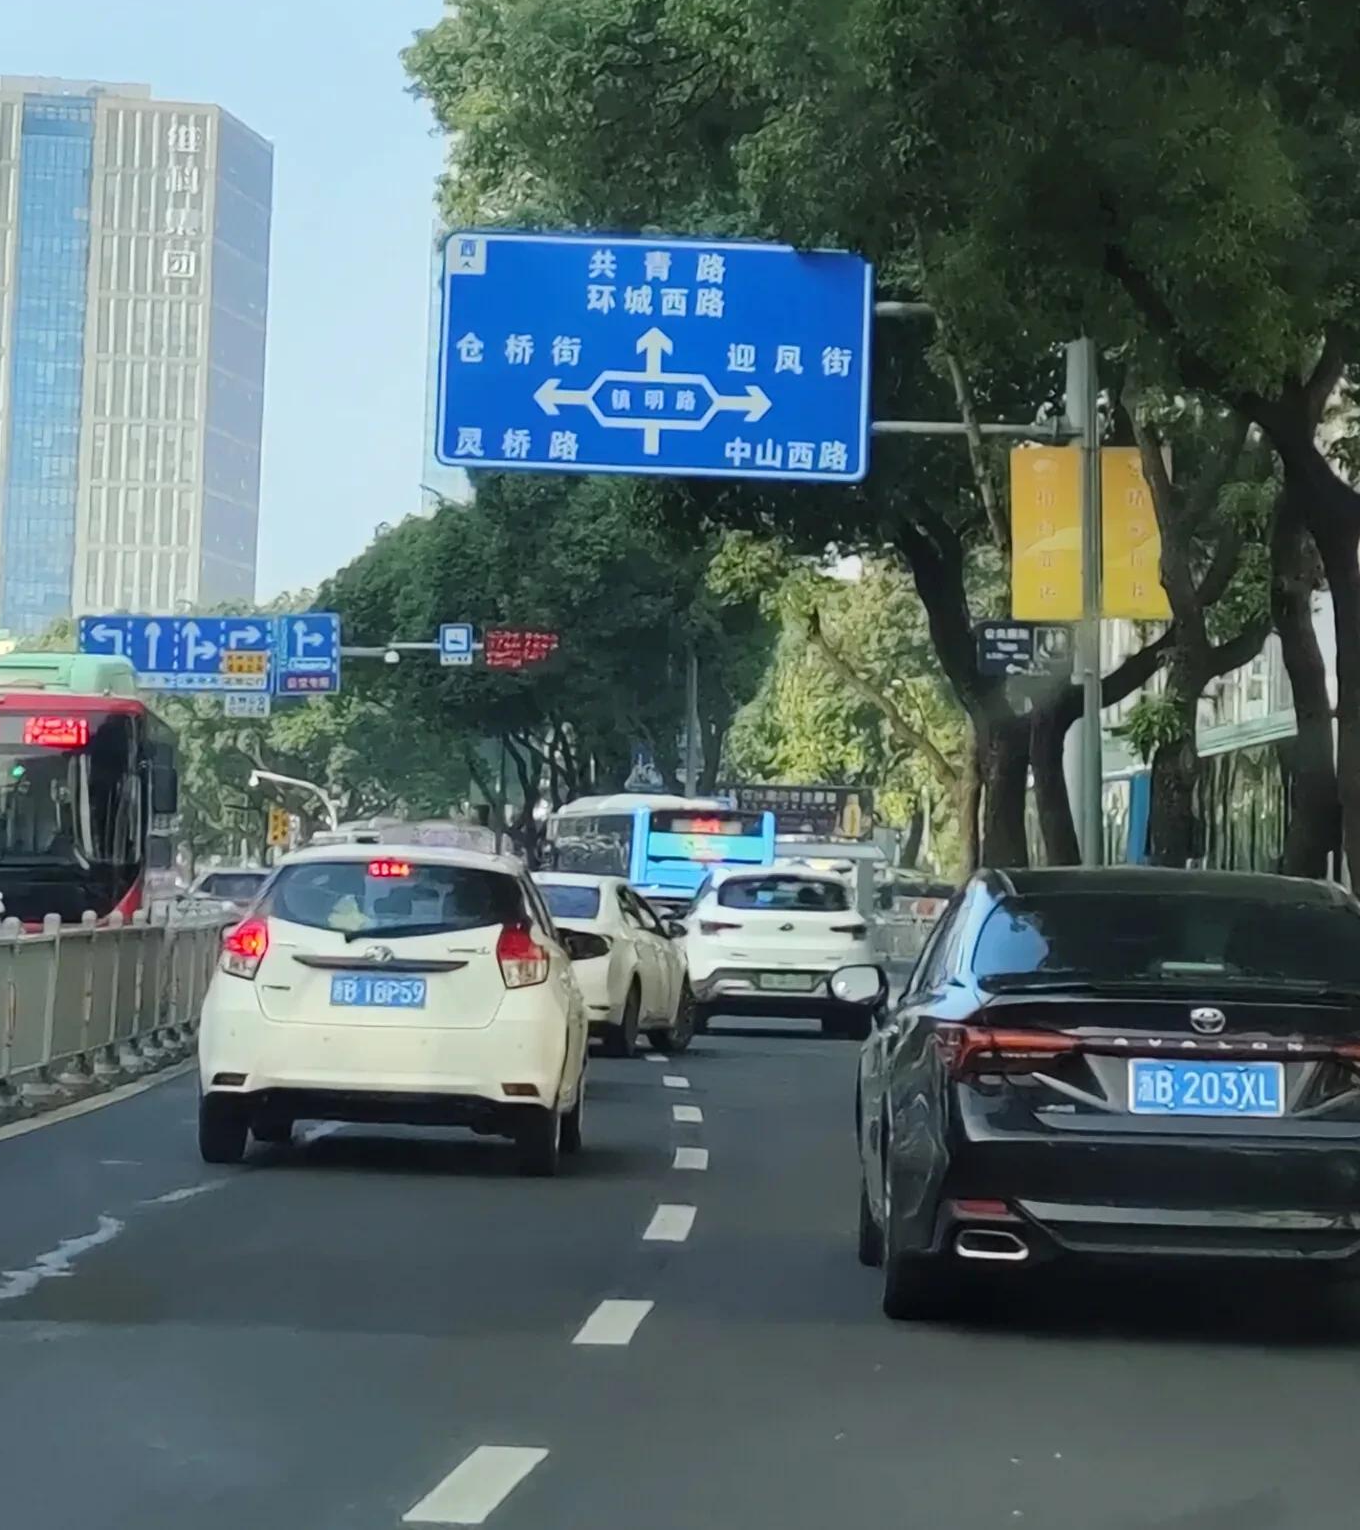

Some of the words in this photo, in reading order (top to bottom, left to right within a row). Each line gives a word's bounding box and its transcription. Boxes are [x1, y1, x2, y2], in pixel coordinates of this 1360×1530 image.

[588, 249, 726, 284] 共青路
[587, 285, 725, 319] 环城西路
[456, 332, 582, 366] 仓桥街
[727, 344, 853, 377] 迎凤街
[611, 388, 696, 412] 镇明路
[454, 427, 579, 461] 灵桥路
[724, 437, 848, 471] 中山西路
